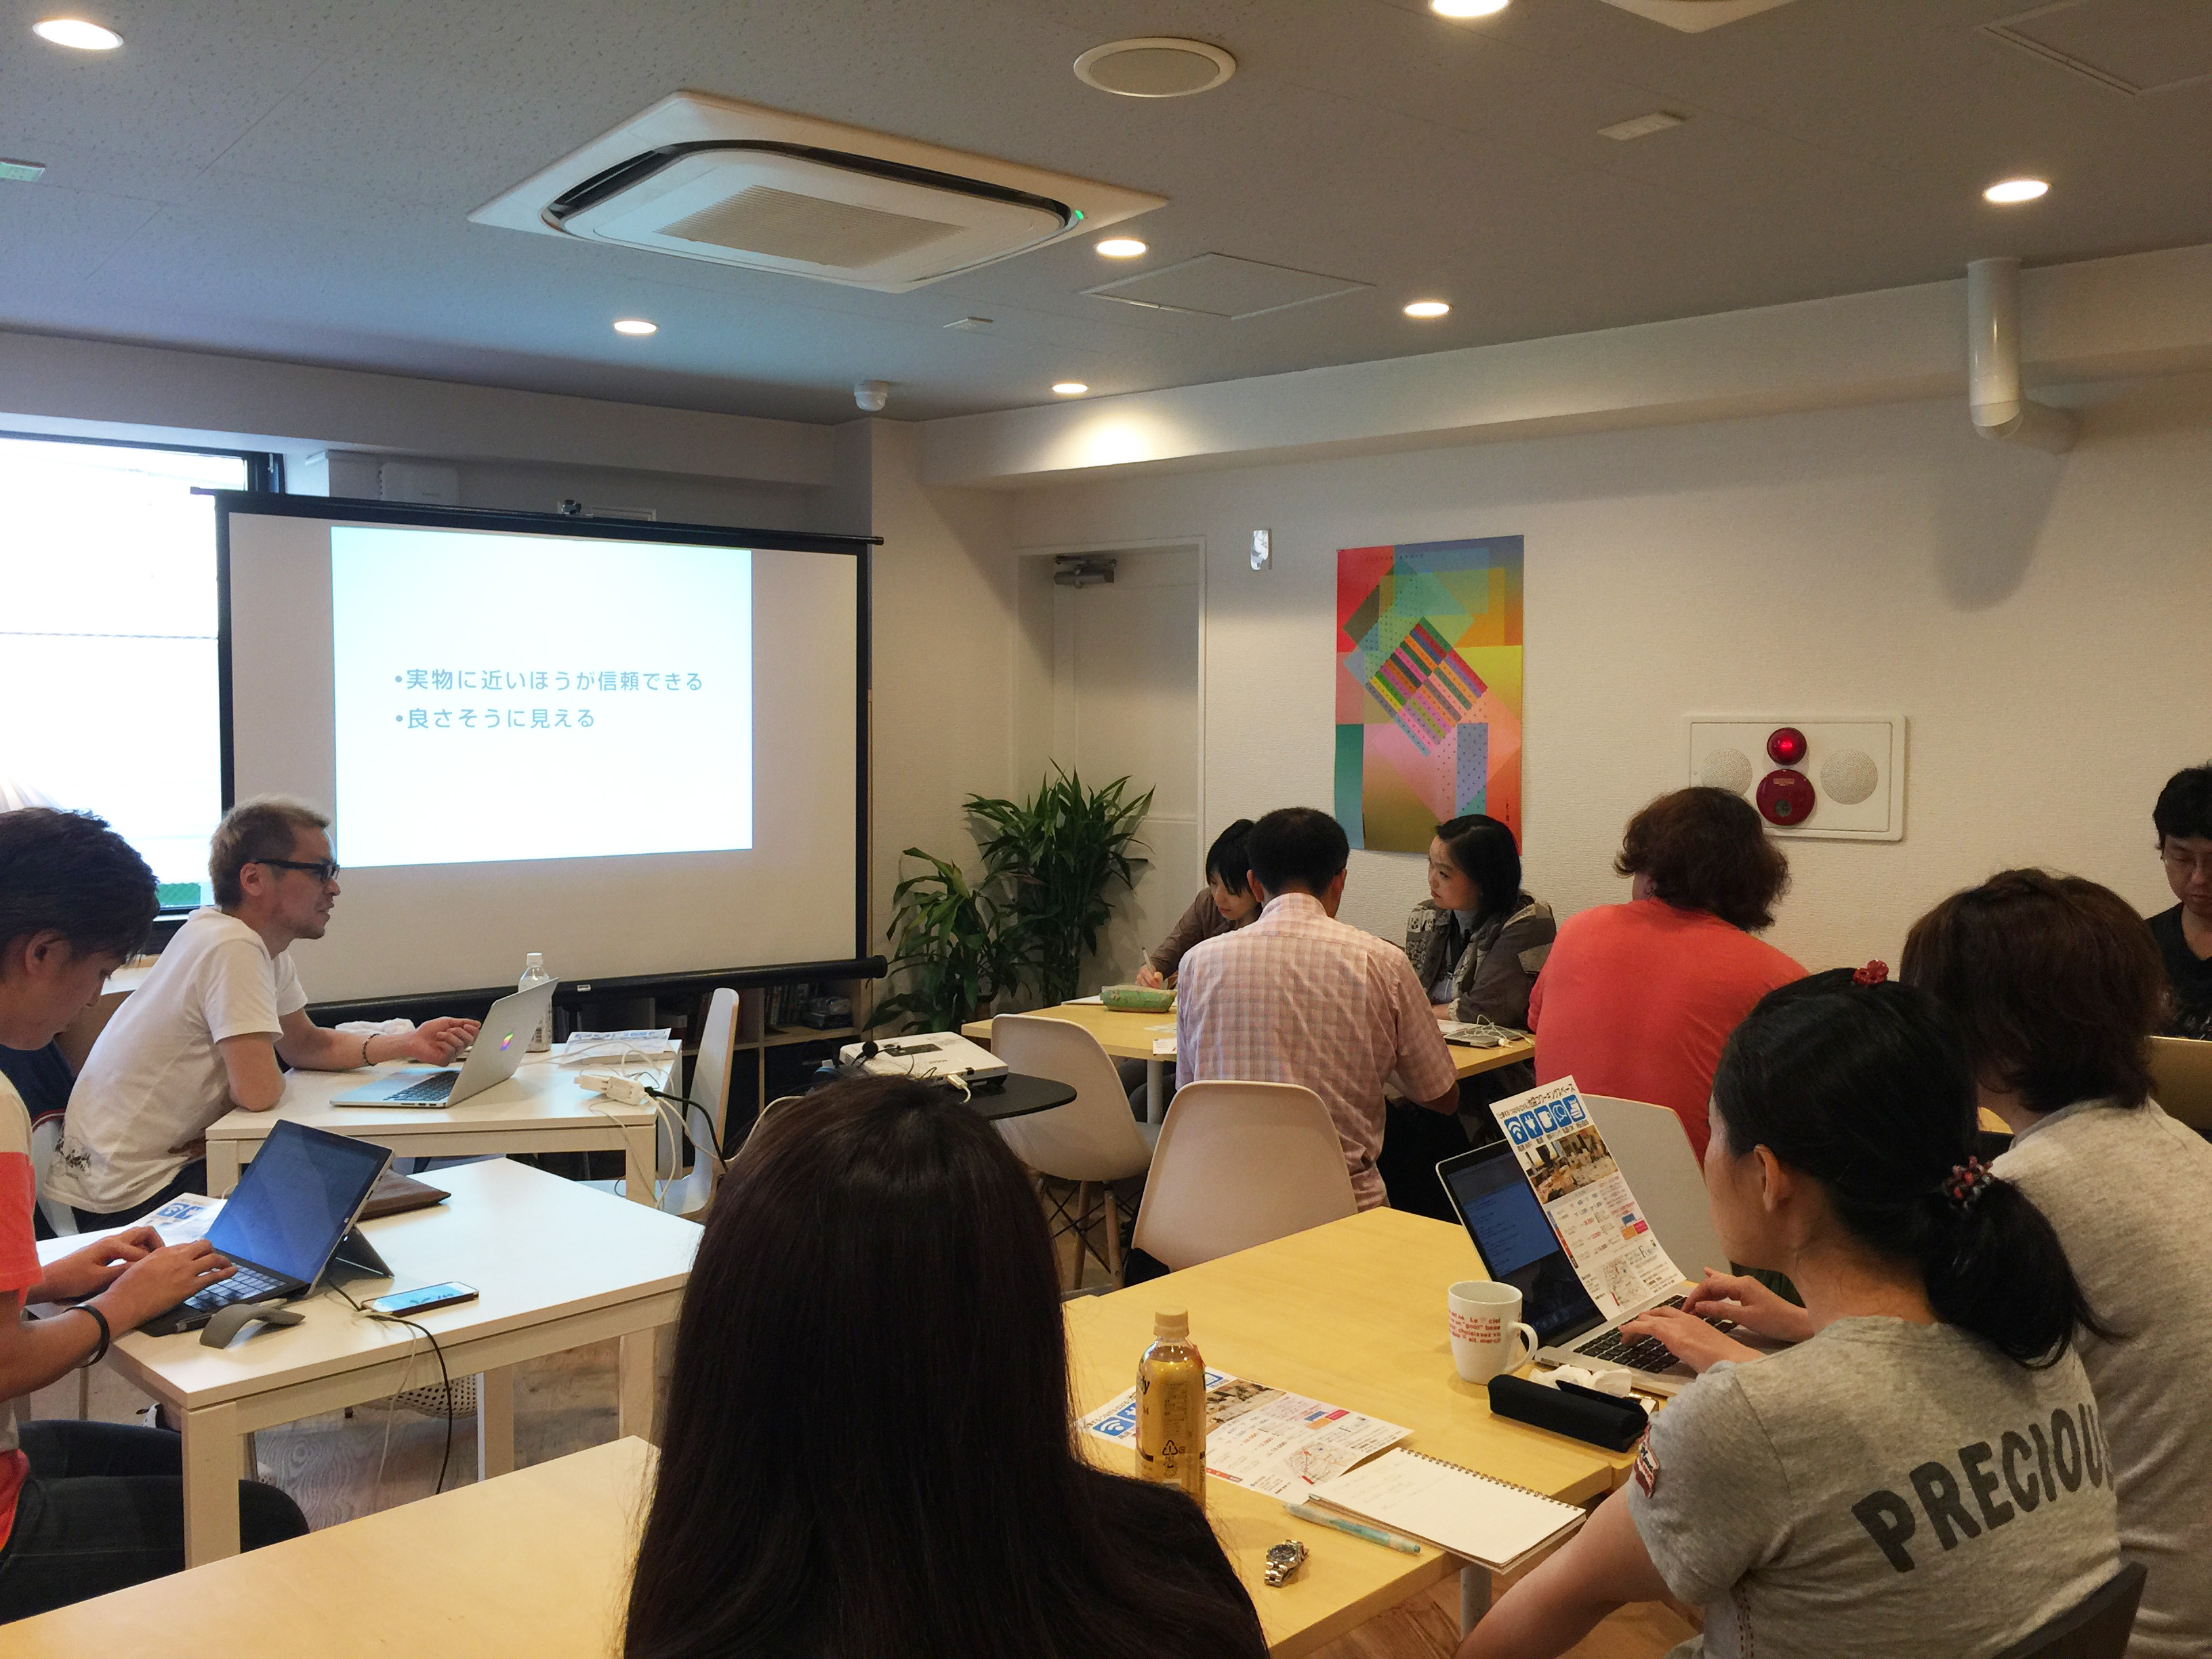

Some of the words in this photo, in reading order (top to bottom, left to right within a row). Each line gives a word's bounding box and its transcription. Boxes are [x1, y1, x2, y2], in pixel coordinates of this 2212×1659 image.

[407, 708, 594, 729] 良さそうに見える
